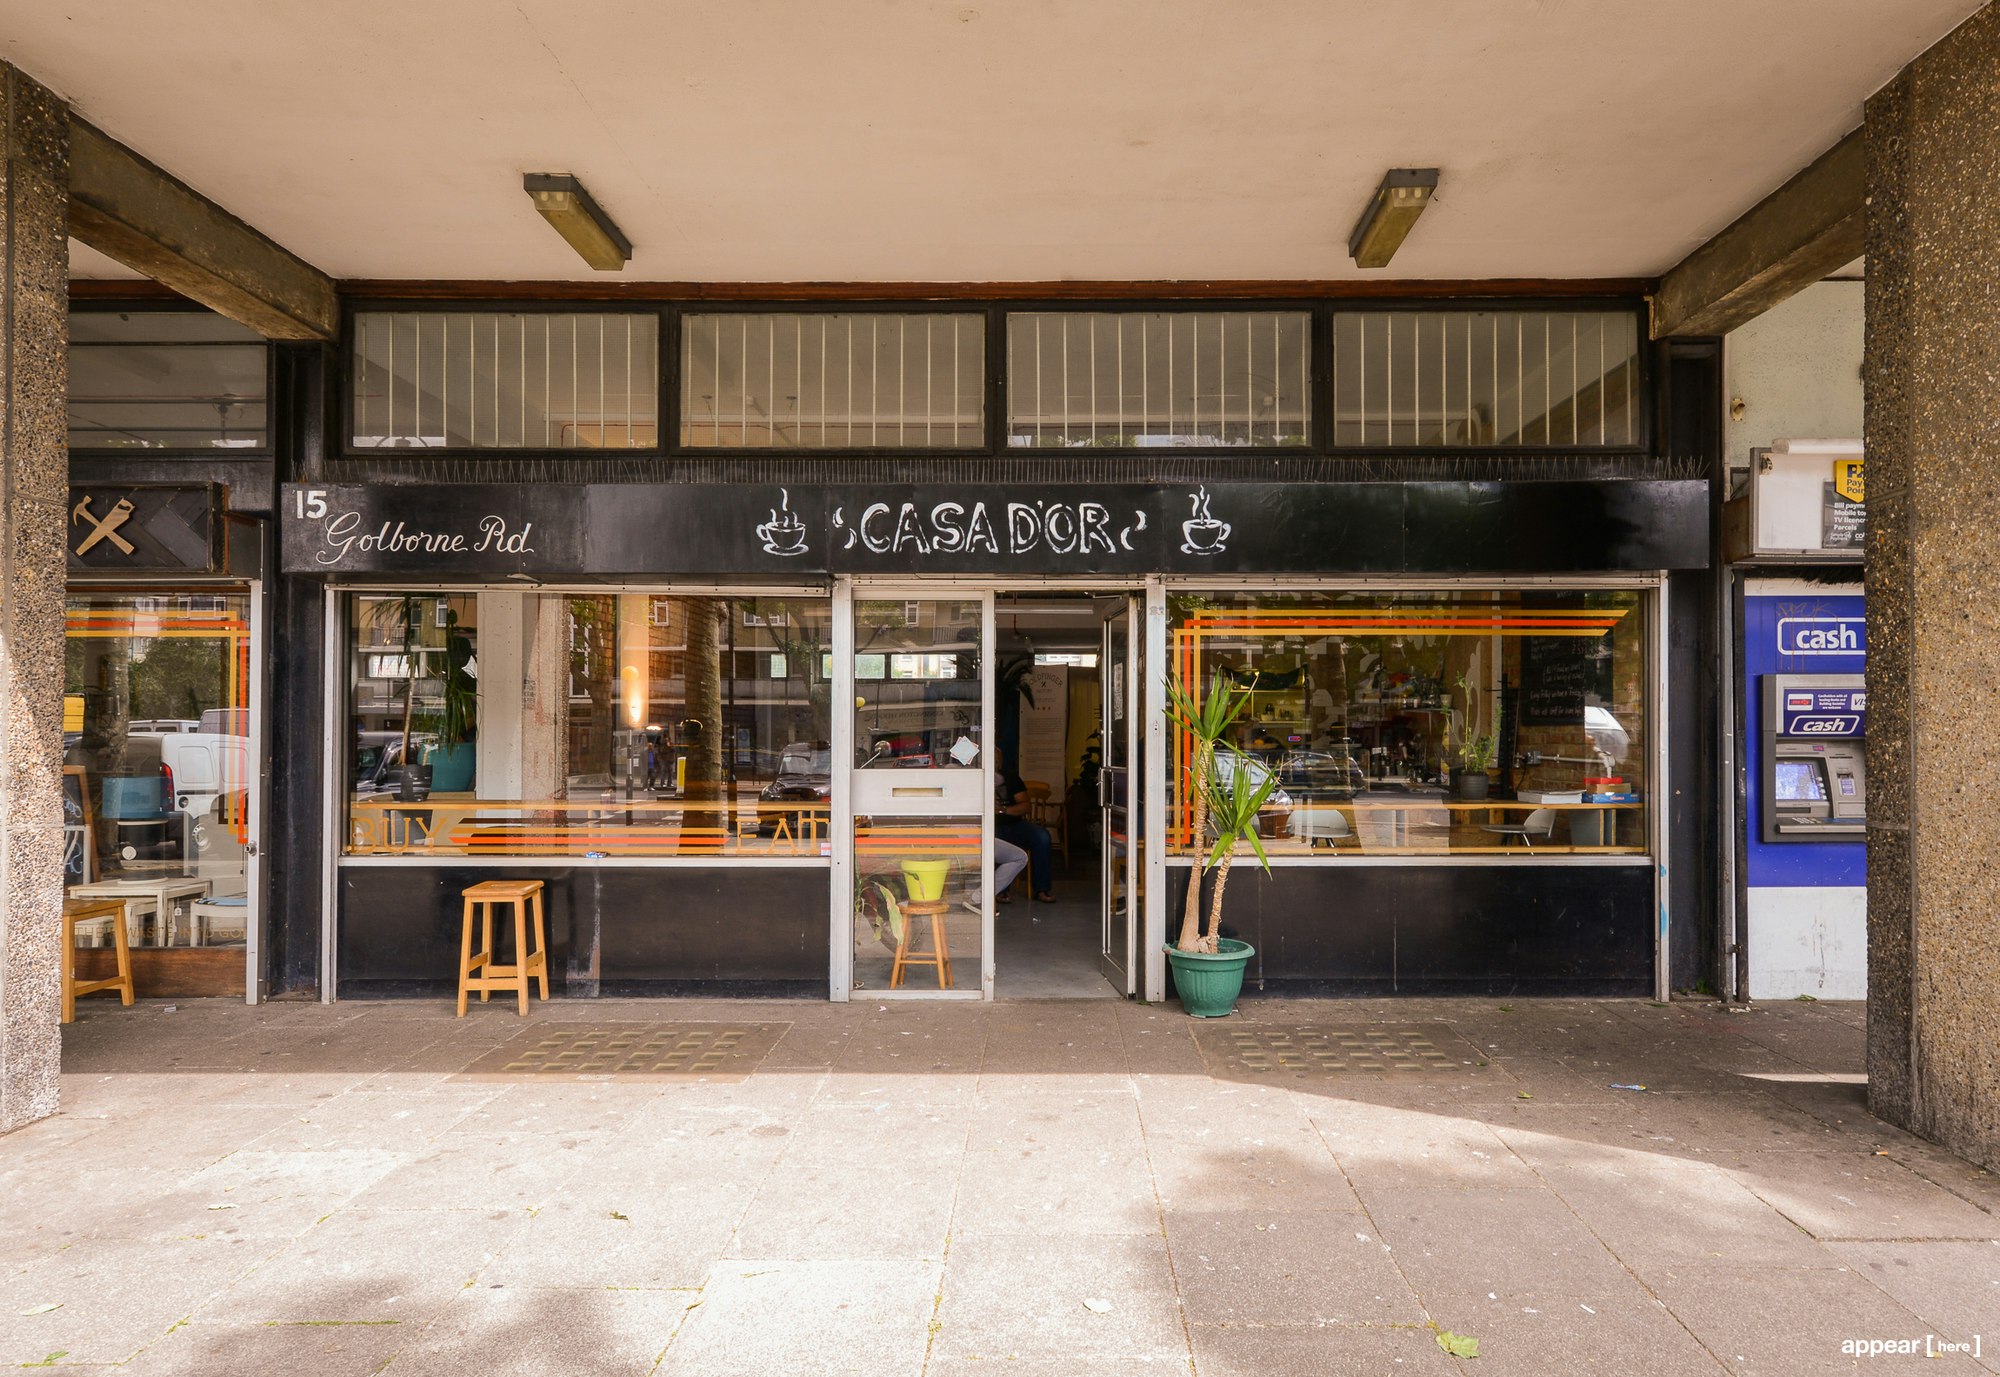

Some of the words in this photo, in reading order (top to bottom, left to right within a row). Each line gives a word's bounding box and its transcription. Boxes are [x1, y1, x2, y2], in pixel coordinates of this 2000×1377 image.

[1847, 479, 1863, 488] Pay
[295, 490, 328, 519] 15
[315, 511, 468, 564] Golborne
[474, 514, 535, 554] Rd
[861, 501, 999, 554] CASA
[1006, 499, 1117, 554] D'OR
[1796, 624, 1857, 649] cash
[1027, 672, 1064, 688] OLDFINGER
[1802, 718, 1846, 732] cash
[349, 816, 447, 854] BUY
[735, 817, 830, 855] EAT
